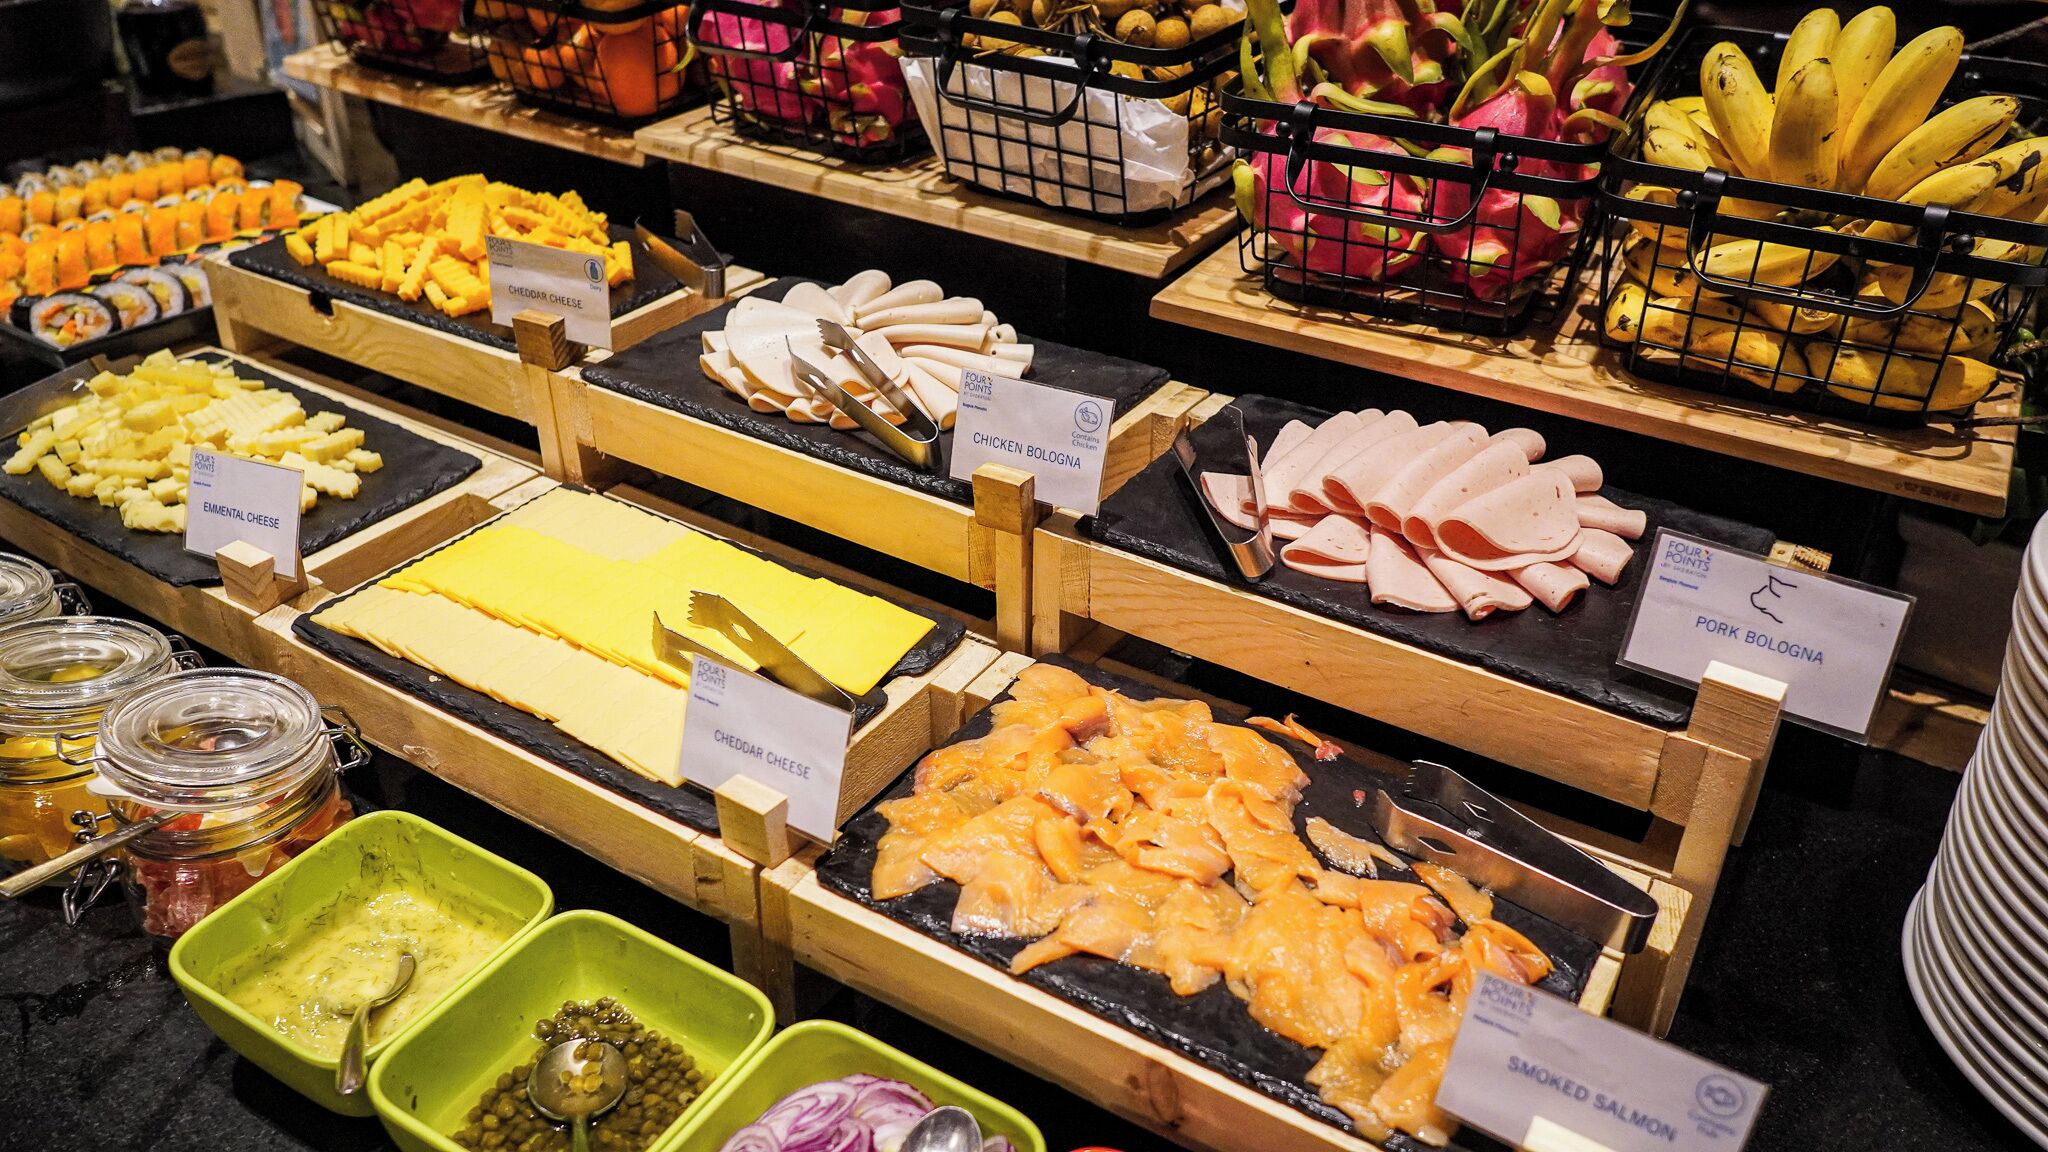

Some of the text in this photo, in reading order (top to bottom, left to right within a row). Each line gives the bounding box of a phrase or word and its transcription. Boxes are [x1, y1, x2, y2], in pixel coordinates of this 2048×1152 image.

[508, 285, 583, 309] CHEDDAR CHEESE
[964, 381, 992, 395] POINTS
[965, 372, 987, 384] FOUR
[1071, 431, 1100, 443] Contains
[1072, 439, 1098, 451] Chicken
[195, 453, 211, 463] FOUR
[973, 432, 1081, 469] CHICKEN BOLOGNA
[194, 461, 215, 472] POINTS
[203, 501, 280, 529] EMMENTAL CHEESE
[1668, 540, 1702, 558] FOUR
[1665, 550, 1710, 572] POINTS
[1695, 615, 1823, 664] PORK BOLOGNA
[698, 660, 720, 677] FOUR
[697, 670, 725, 689] POINTS
[714, 729, 811, 779] CHEDDAR CHEESE
[1483, 974, 1523, 998] FOUR
[1480, 986, 1534, 1017] POINTS
[1507, 1055, 1677, 1142] SMOKED SALMON
